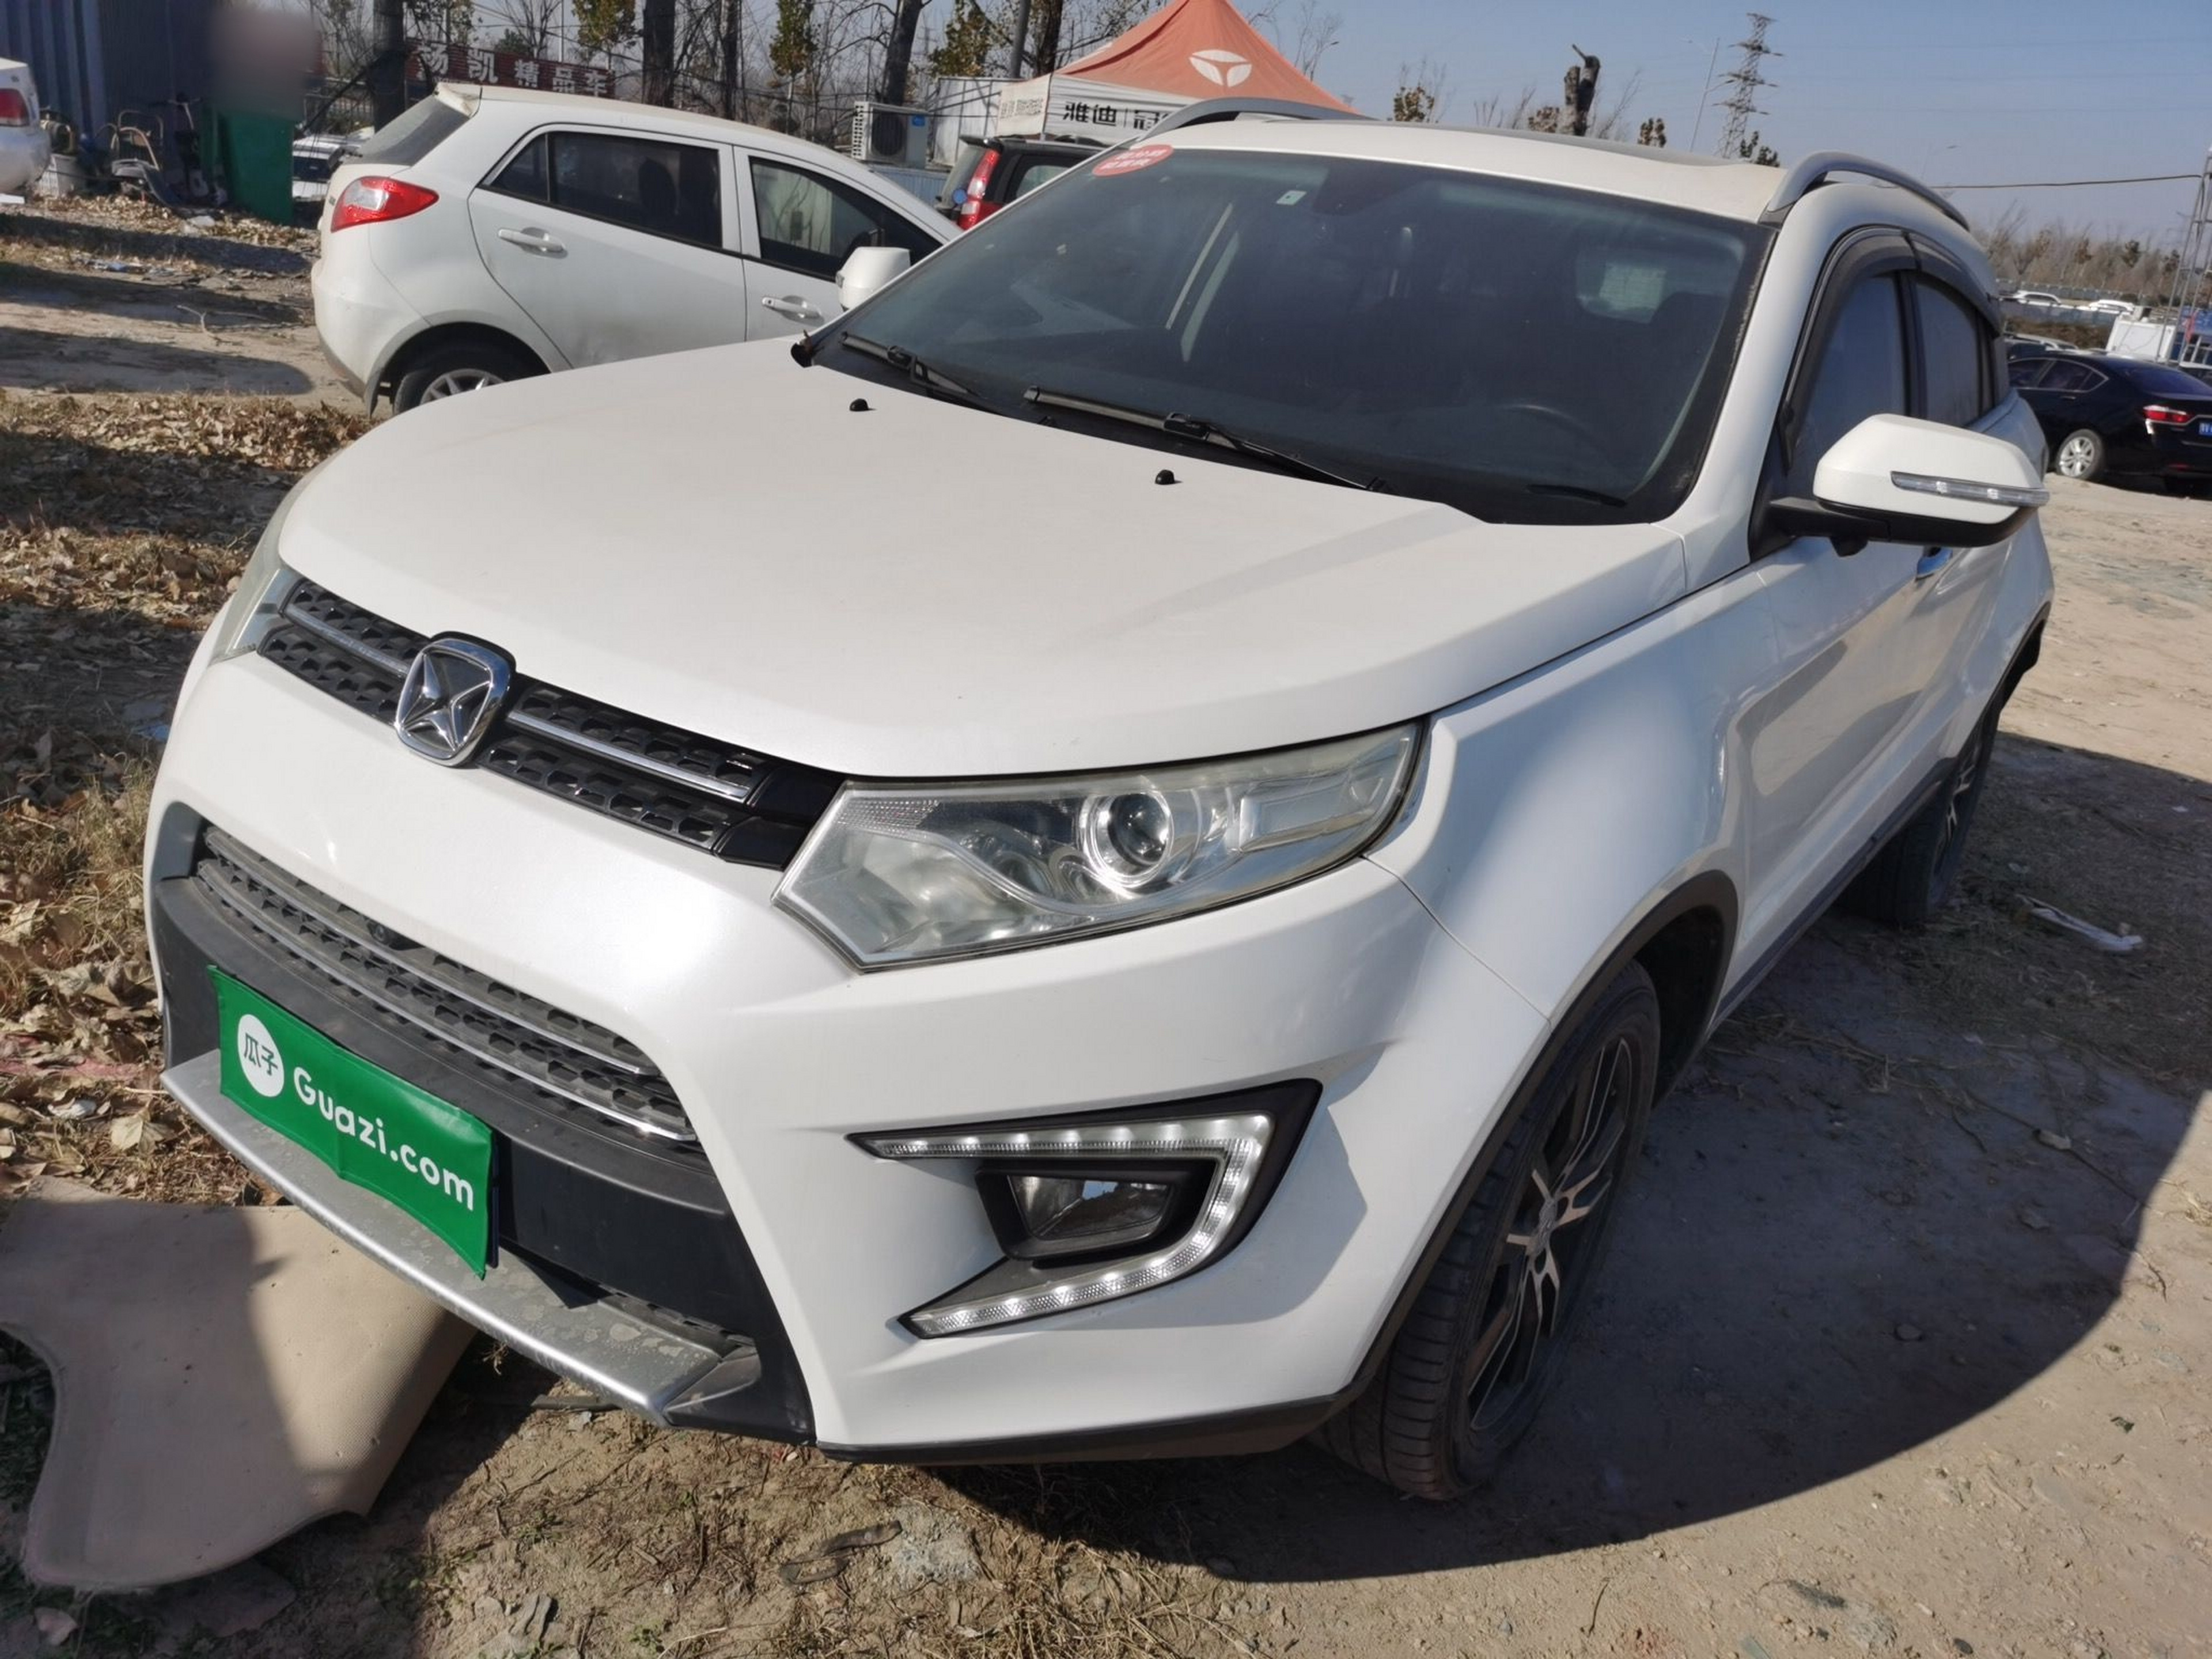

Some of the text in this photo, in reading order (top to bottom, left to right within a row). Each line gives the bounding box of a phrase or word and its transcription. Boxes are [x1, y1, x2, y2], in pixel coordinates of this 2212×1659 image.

[1063, 102, 1117, 127] 雅迪
[1134, 109, 1169, 131] 冠
[243, 1033, 278, 1075] 瓜子
[293, 1066, 474, 1211] Guazi.com
